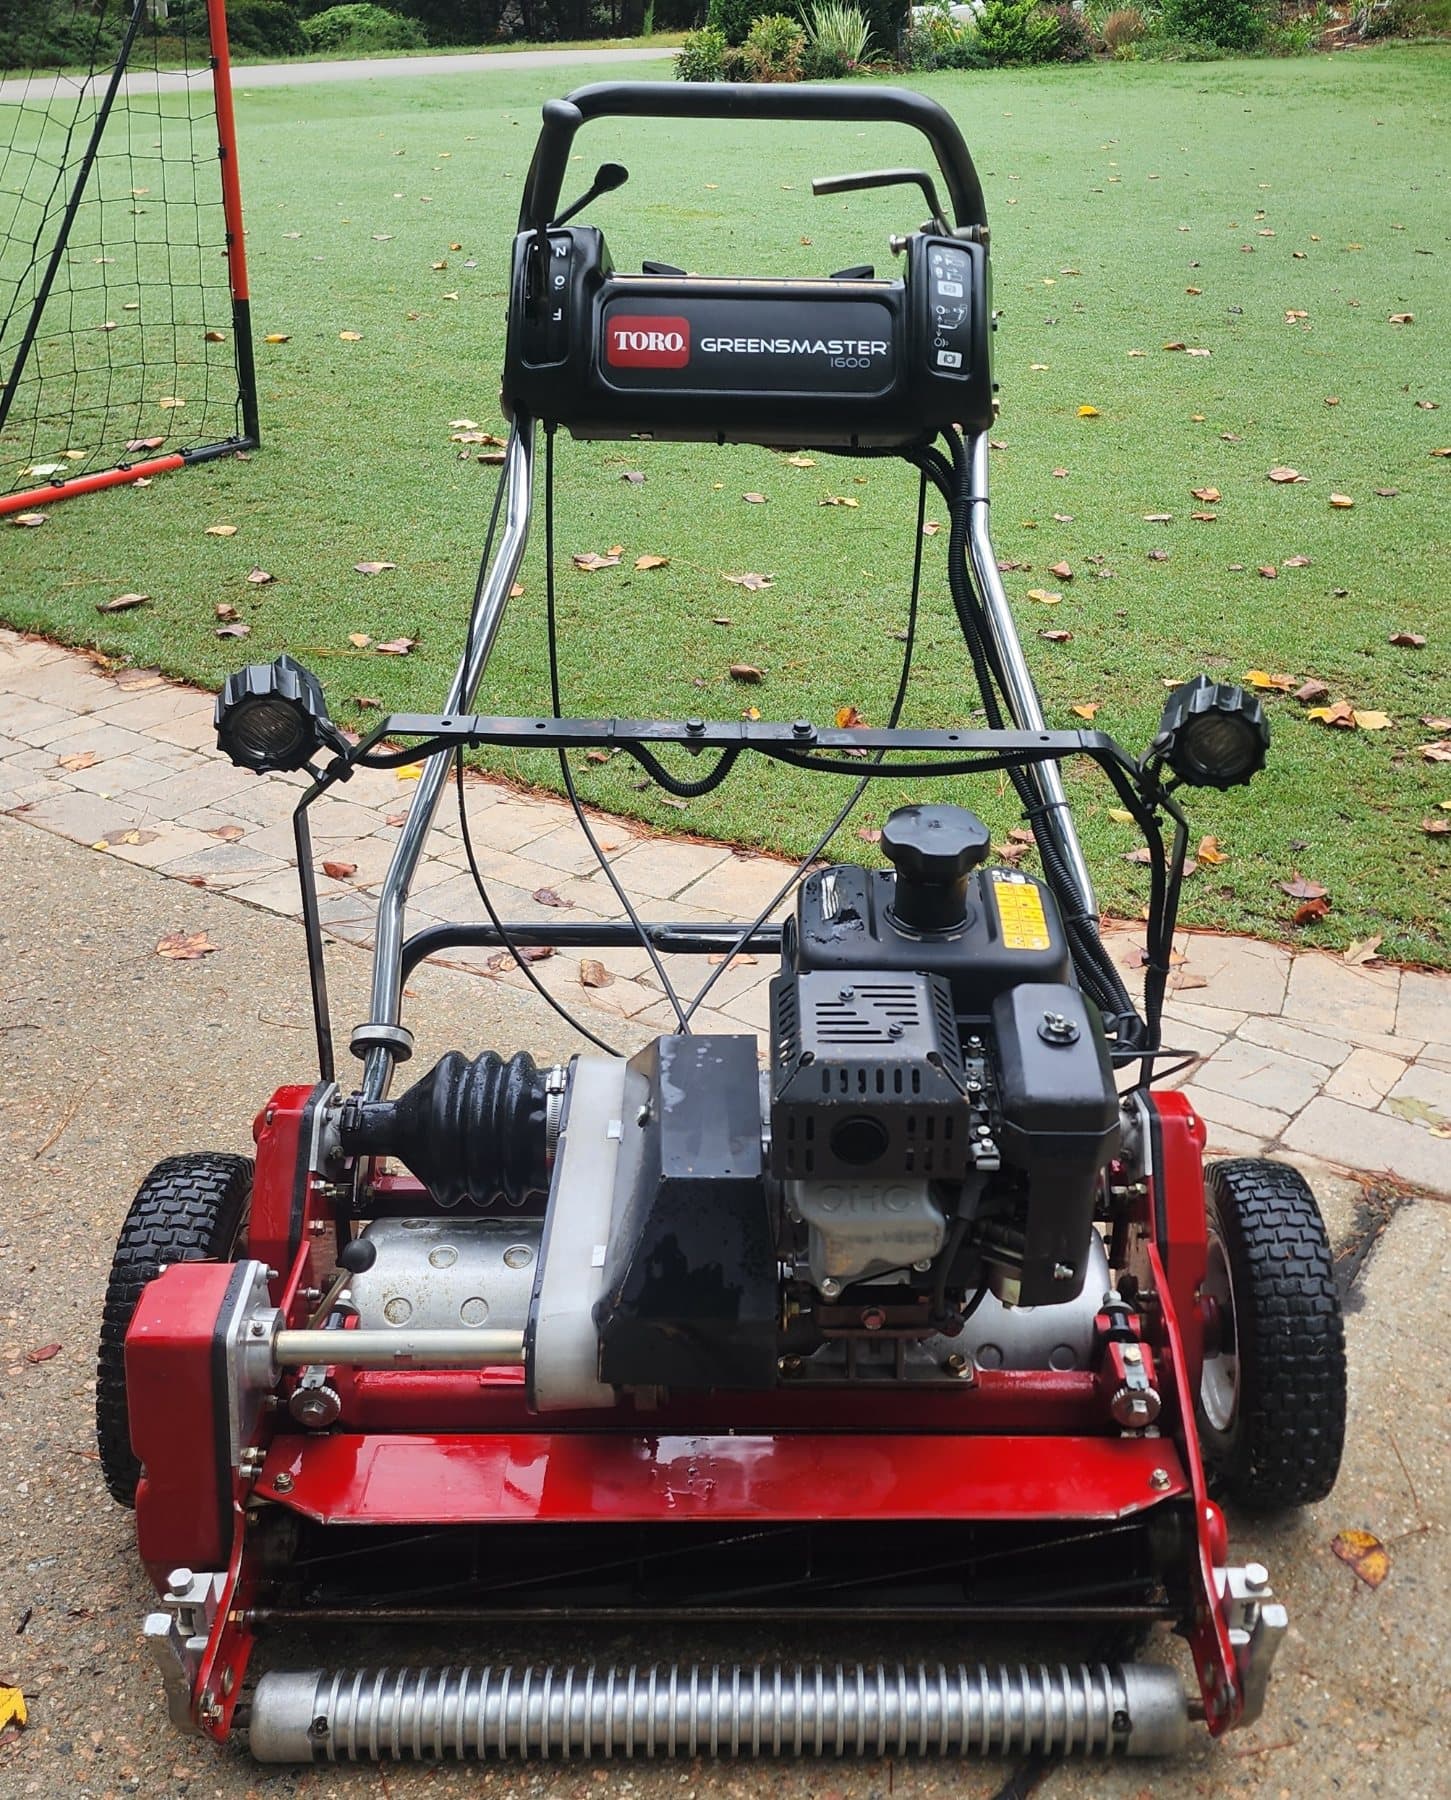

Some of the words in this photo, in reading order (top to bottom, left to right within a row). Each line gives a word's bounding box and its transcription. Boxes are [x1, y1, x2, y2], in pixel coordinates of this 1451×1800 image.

[552, 307, 562, 321] F
[614, 331, 684, 352] TORO
[700, 338, 888, 356] GREENSMASTER
[830, 357, 871, 368] 1600
